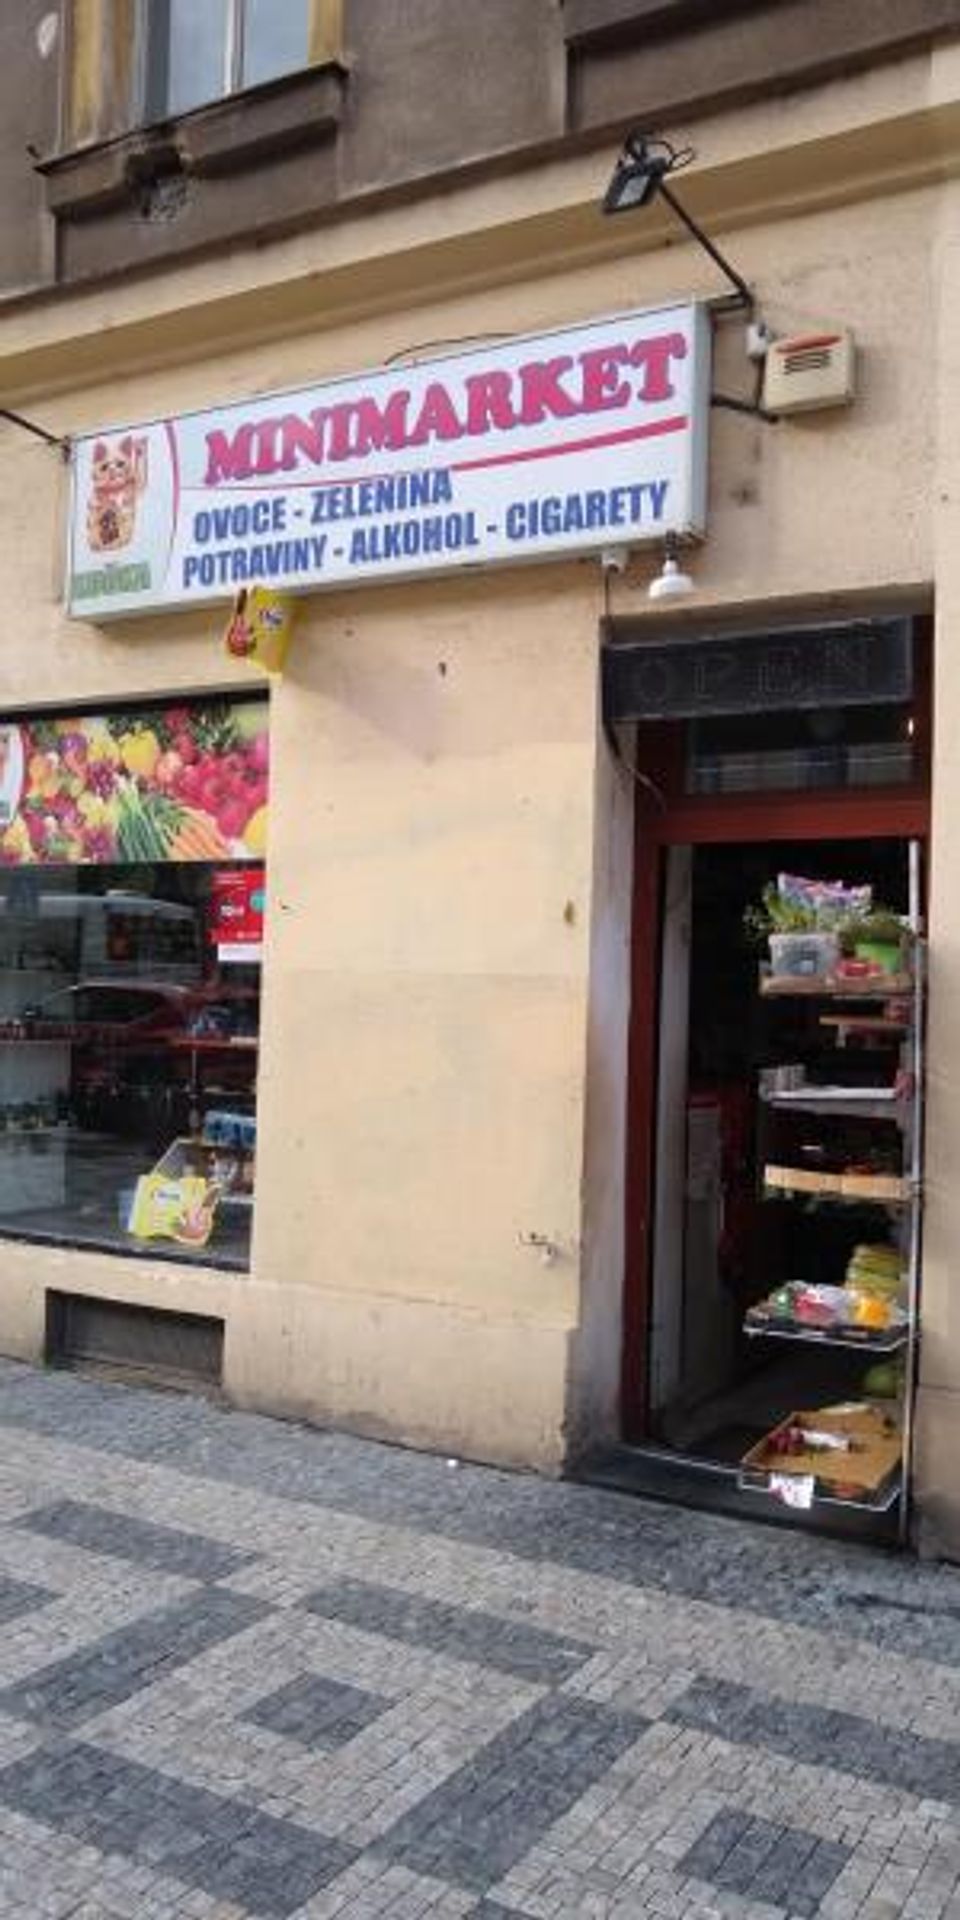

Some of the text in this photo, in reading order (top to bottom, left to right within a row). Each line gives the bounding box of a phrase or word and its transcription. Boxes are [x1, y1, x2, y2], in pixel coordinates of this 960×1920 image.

[203, 331, 688, 487] MINIMARKET
[183, 534, 328, 588] POTRAVINY
[349, 511, 479, 564] ALKOHOL
[505, 480, 669, 540] CIGARETY
[193, 497, 288, 543] OVOCE
[310, 468, 452, 525] ZELENINA
[637, 634, 872, 706] OPEN
